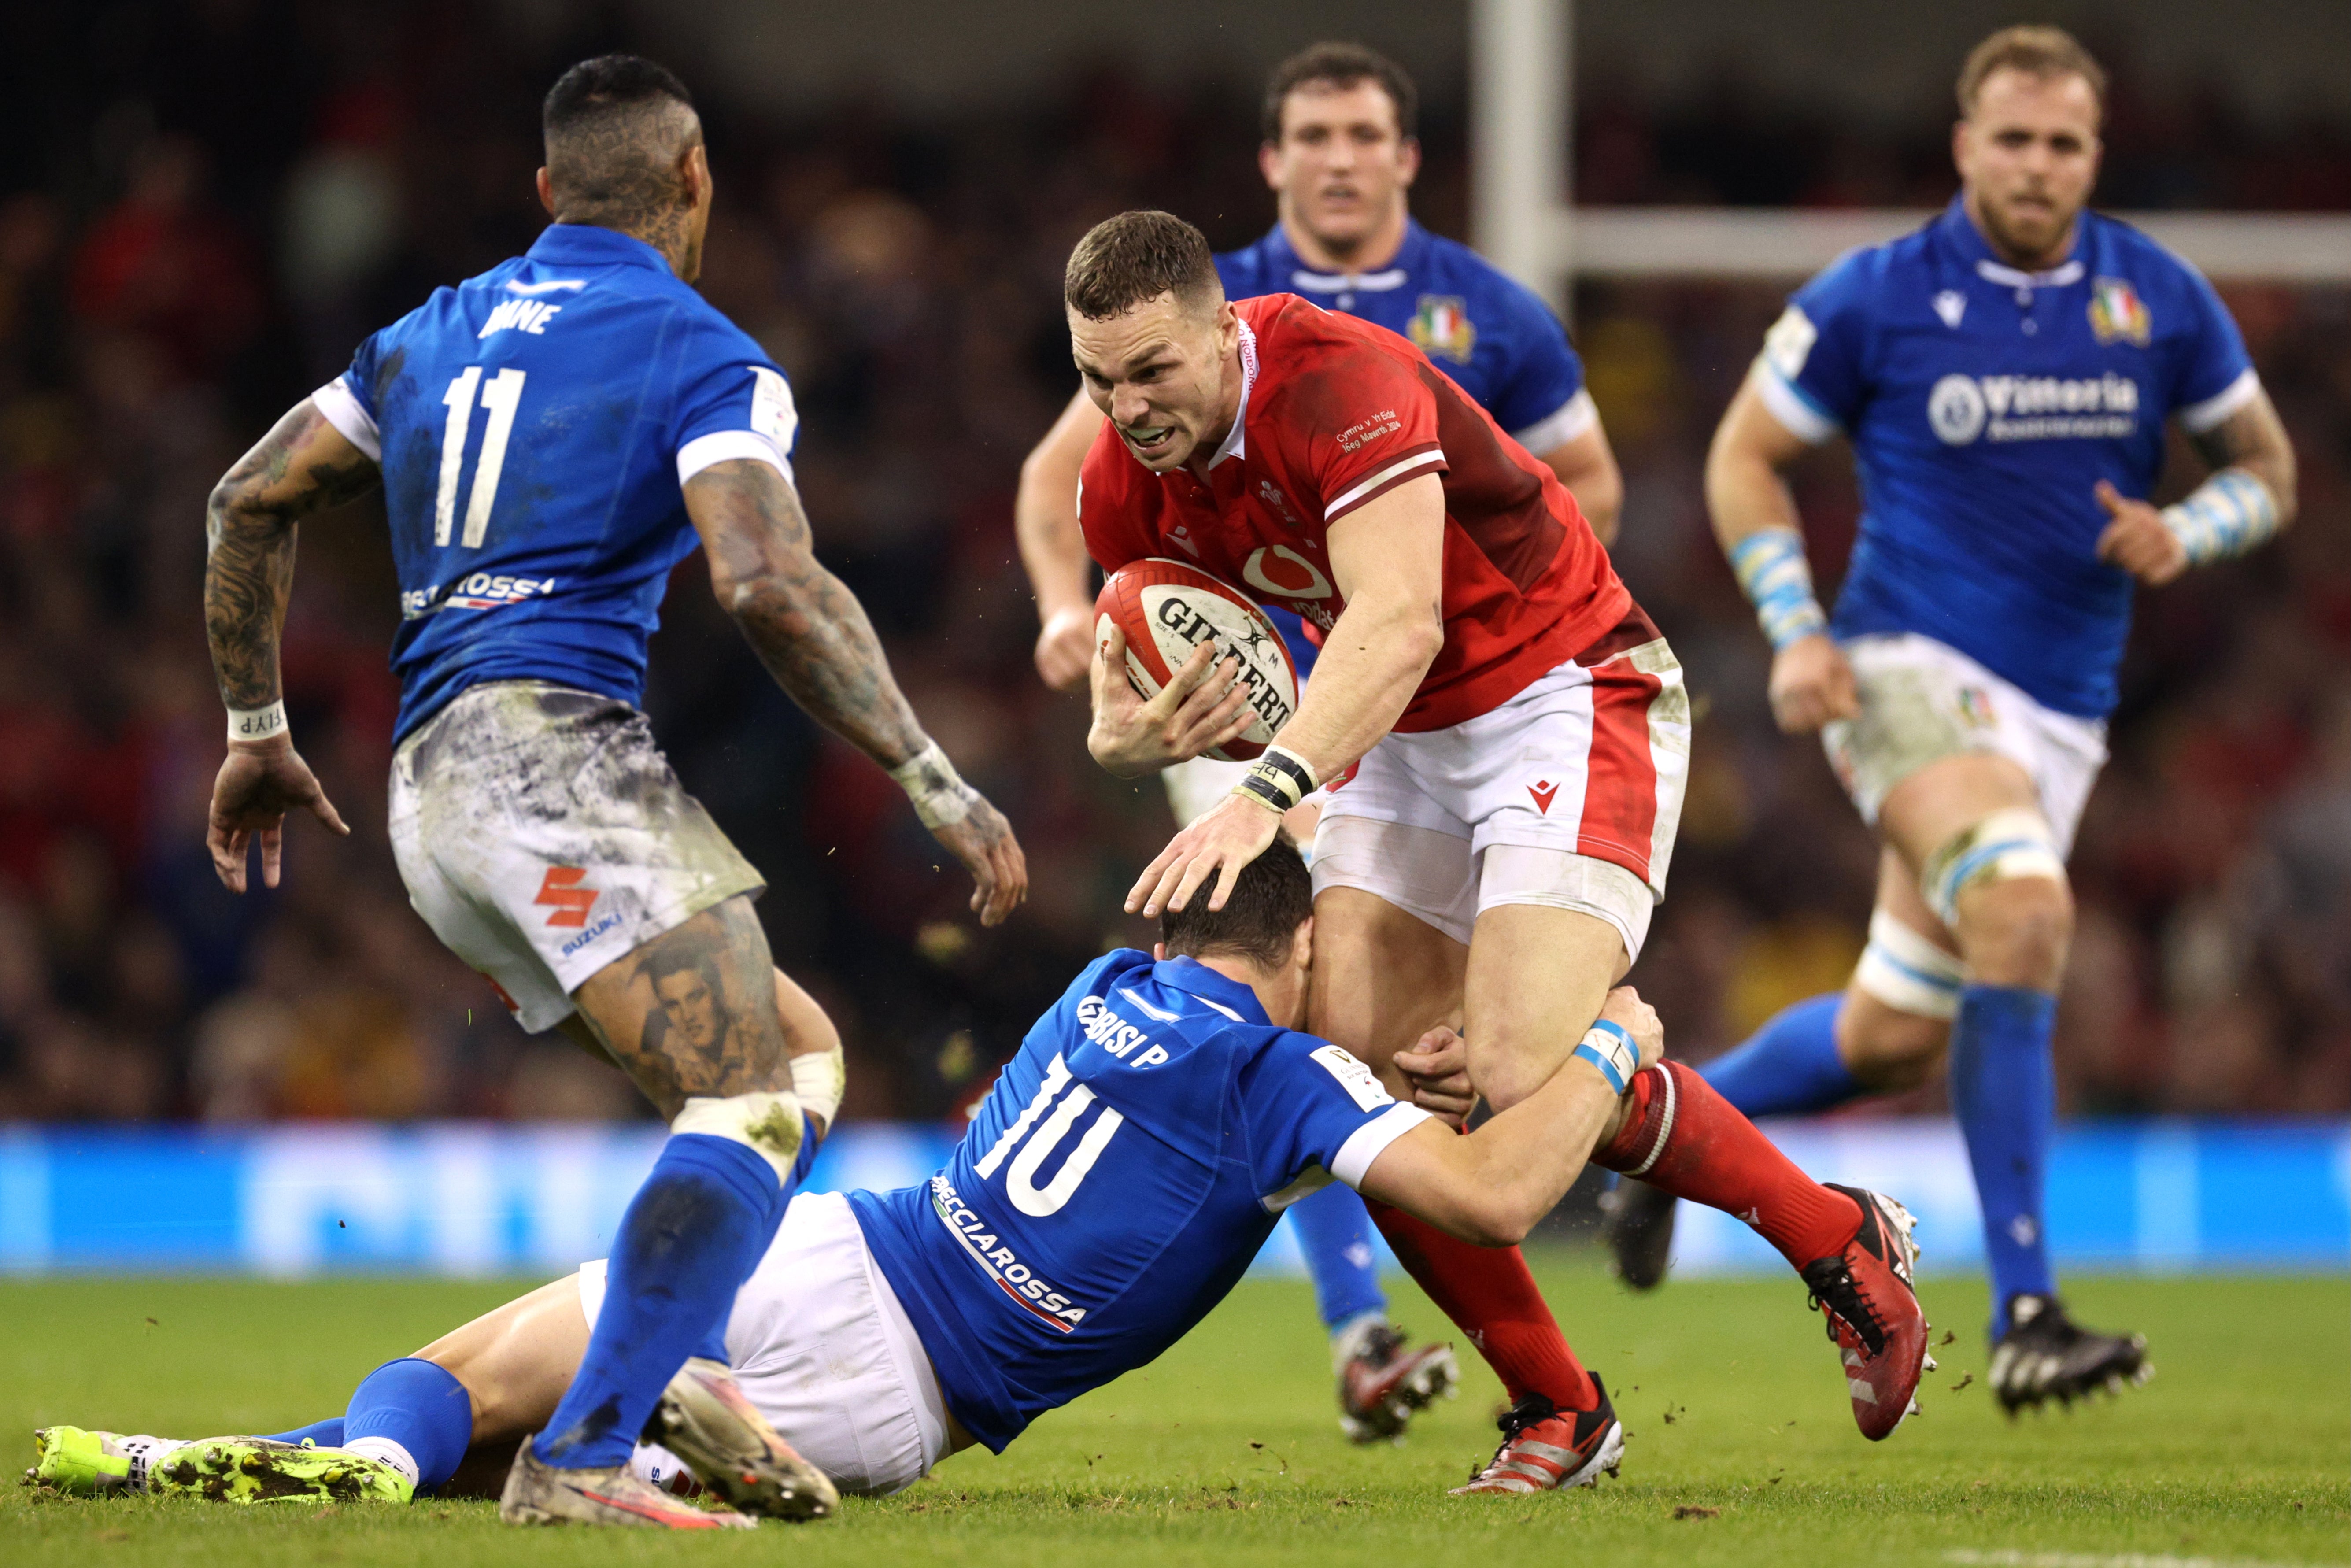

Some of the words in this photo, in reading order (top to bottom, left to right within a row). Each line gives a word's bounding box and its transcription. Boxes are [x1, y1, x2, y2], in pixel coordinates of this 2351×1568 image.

[1336, 423, 1364, 443] Cymru
[1371, 414, 1381, 422] Yr
[1380, 409, 1396, 420] Eidal
[1342, 439, 1361, 453] 16eg
[1360, 425, 1387, 443] Mawrth
[1386, 420, 1401, 432] 2024
[434, 366, 526, 549] 11
[1154, 622, 1168, 633] SIZE
[1159, 598, 1290, 733] GILBERT
[562, 913, 622, 957] SUZUKI
[973, 1051, 1124, 1217] 10
